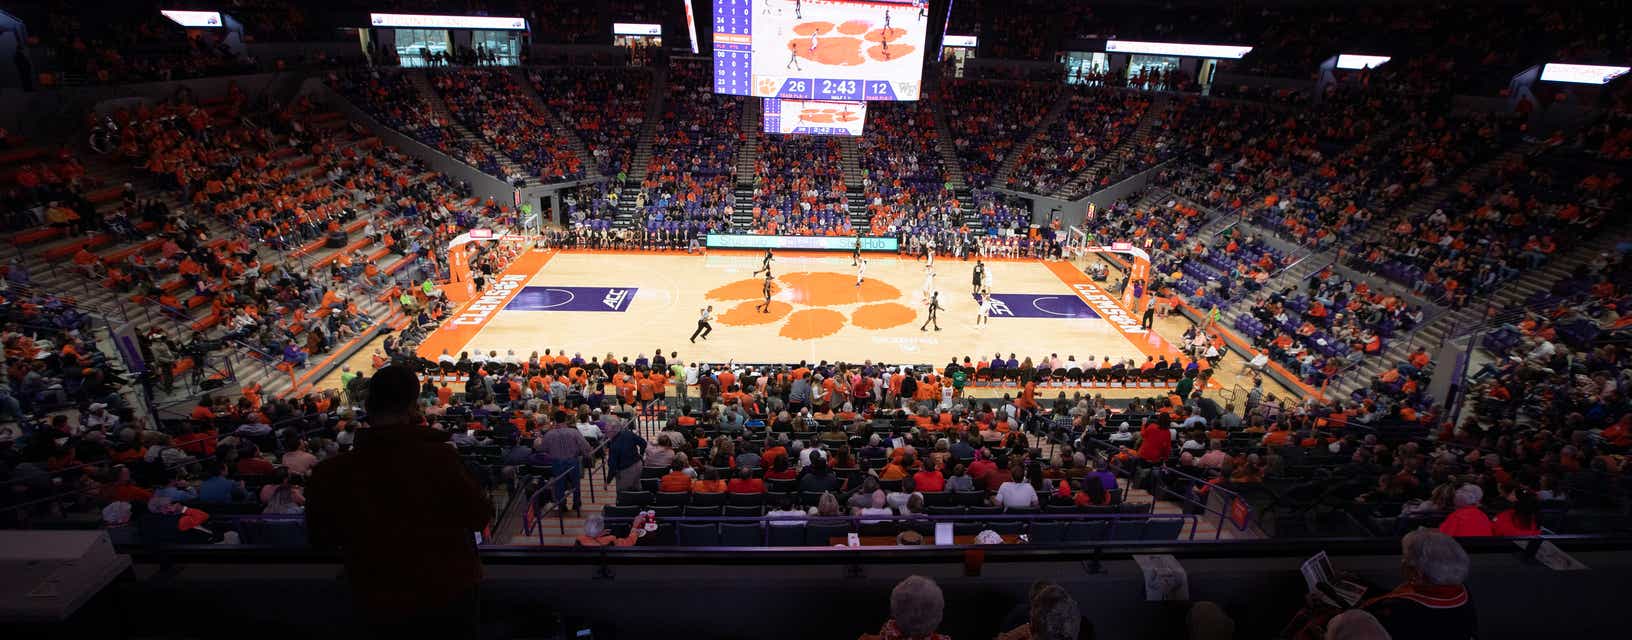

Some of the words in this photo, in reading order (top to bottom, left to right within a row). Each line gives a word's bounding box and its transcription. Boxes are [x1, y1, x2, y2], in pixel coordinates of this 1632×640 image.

[789, 81, 805, 92] 26
[822, 80, 856, 94] 2:43
[872, 83, 887, 94] 12
[453, 274, 528, 325] CLEMSON
[602, 288, 625, 309] ACC
[1072, 283, 1149, 334] CLEMSON
